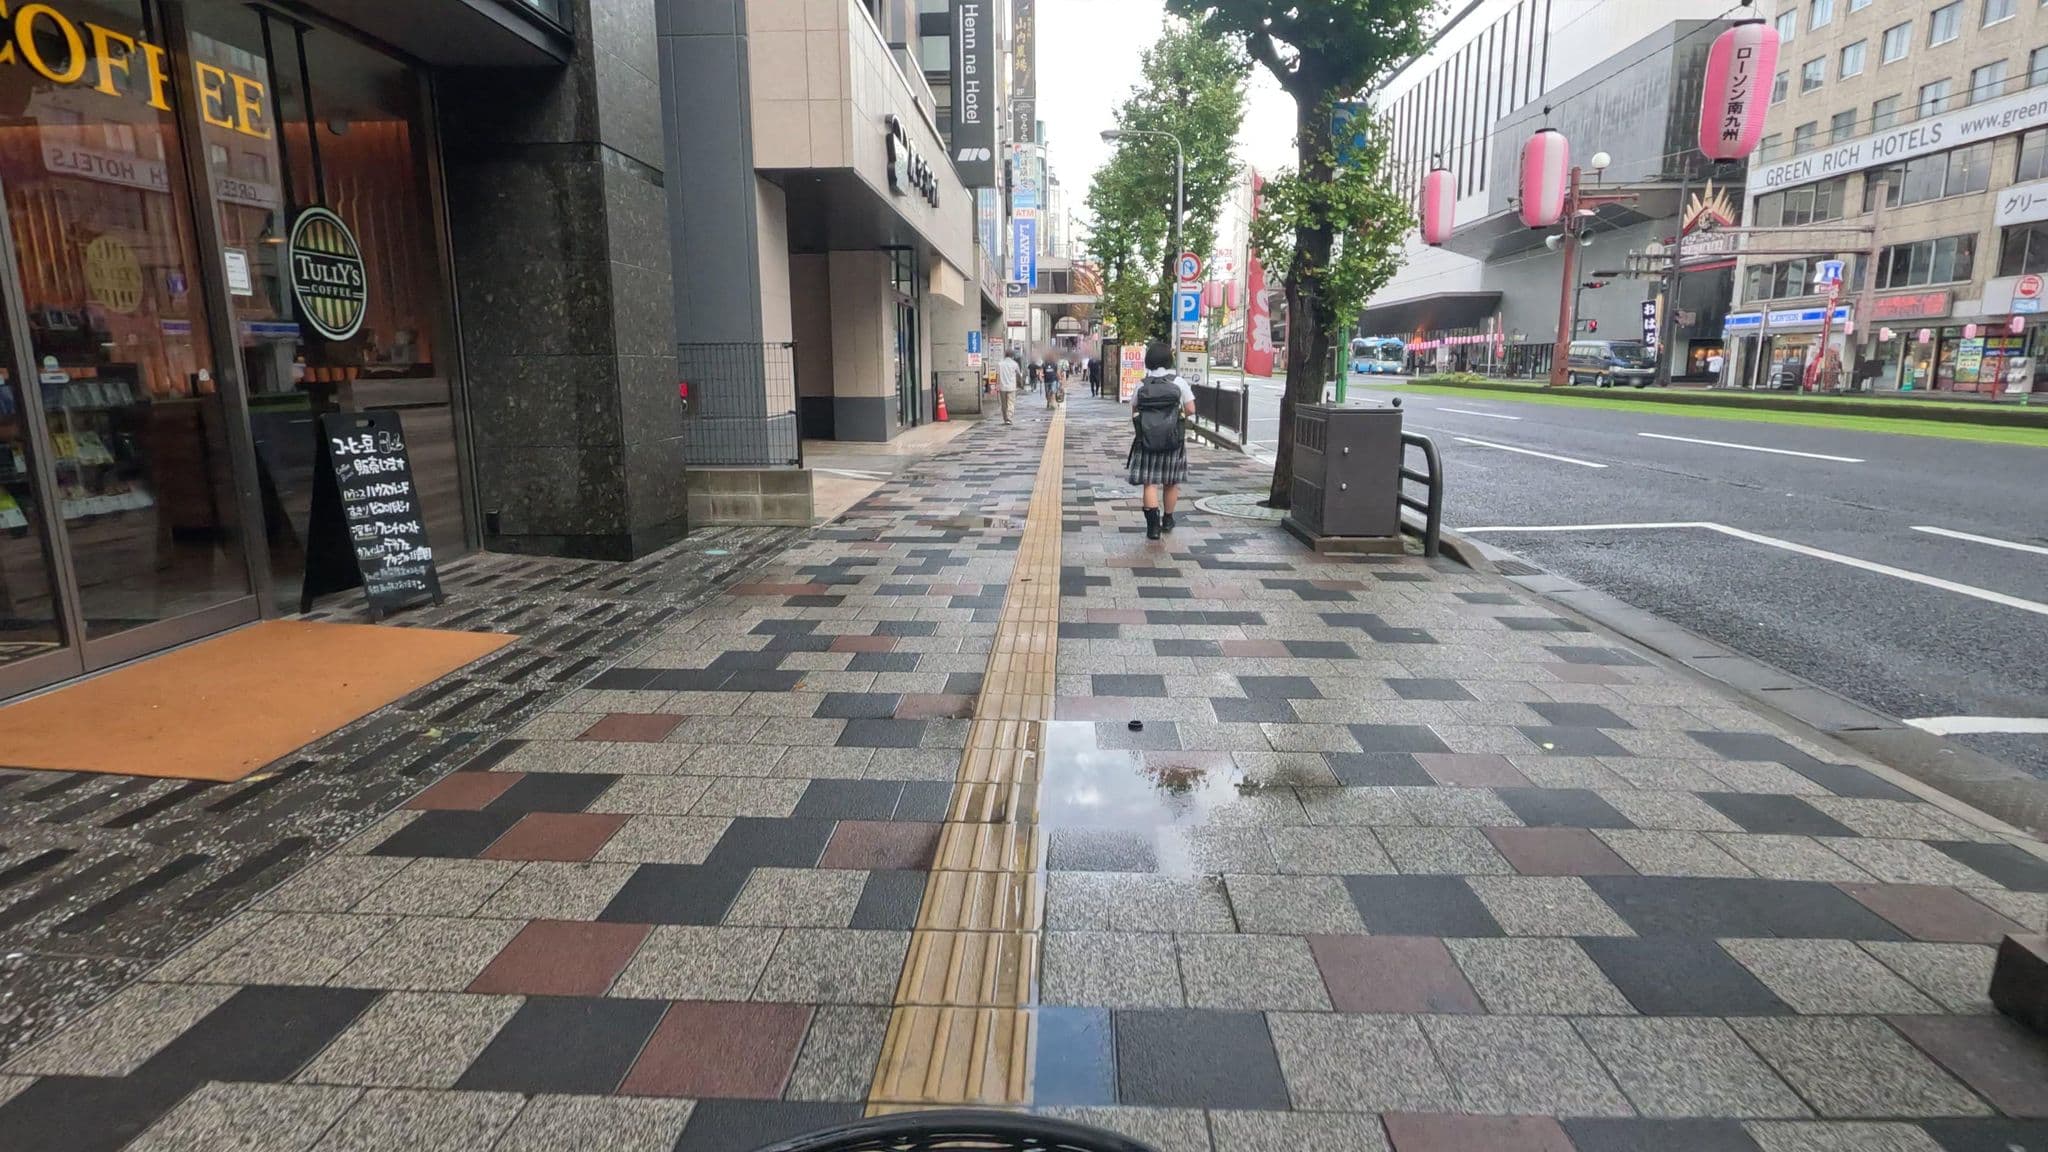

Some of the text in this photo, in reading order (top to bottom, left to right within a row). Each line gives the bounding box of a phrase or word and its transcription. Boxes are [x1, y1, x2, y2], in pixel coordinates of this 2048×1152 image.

[964, 4, 981, 124] Henn na Hotel
[1721, 47, 1752, 142] ローソン南九州
[1765, 122, 1943, 188] GREEN RICH HOTELS
[1015, 209, 1035, 218] ATM
[311, 284, 351, 298] COFFEE
[1181, 295, 1196, 319] P
[332, 433, 377, 454] コーヒー豆
[353, 455, 406, 476] 販売します
